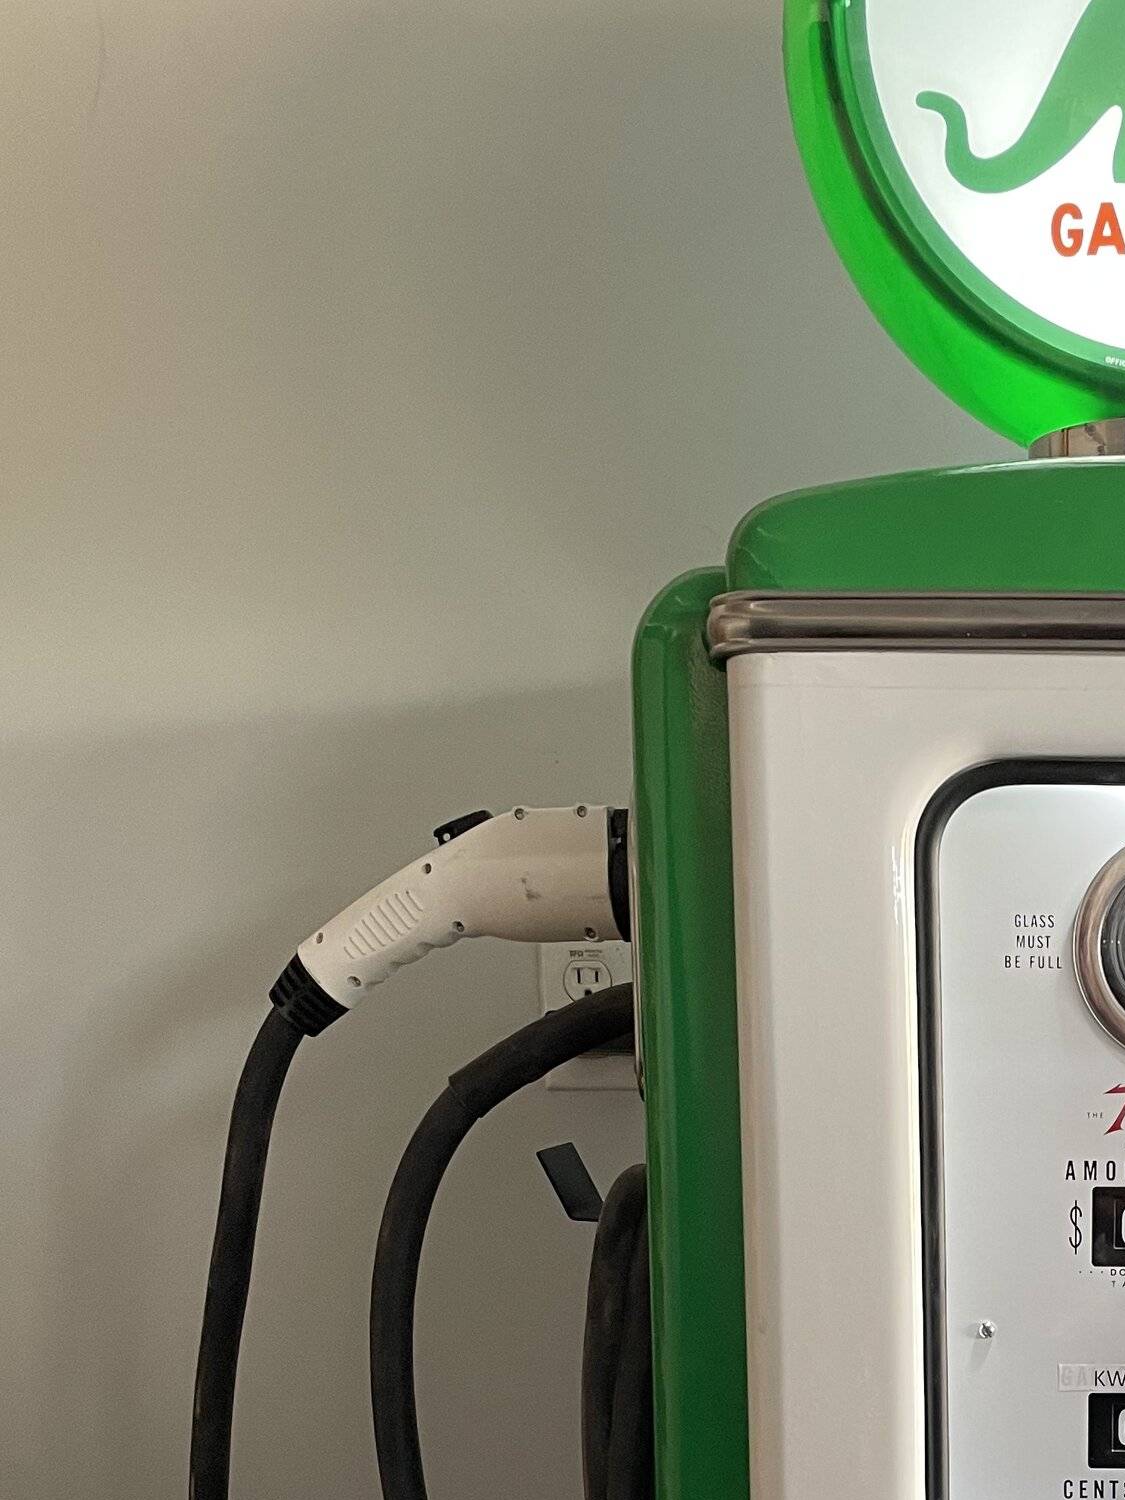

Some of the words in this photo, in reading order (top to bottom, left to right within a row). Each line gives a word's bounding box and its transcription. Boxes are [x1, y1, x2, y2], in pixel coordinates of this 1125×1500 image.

[1014, 914, 1055, 928] GLASS
[1016, 935, 1051, 949] MUST
[1004, 955, 1021, 969] BE
[1030, 956, 1063, 969] FULL
[1069, 1200, 1083, 1255] $
